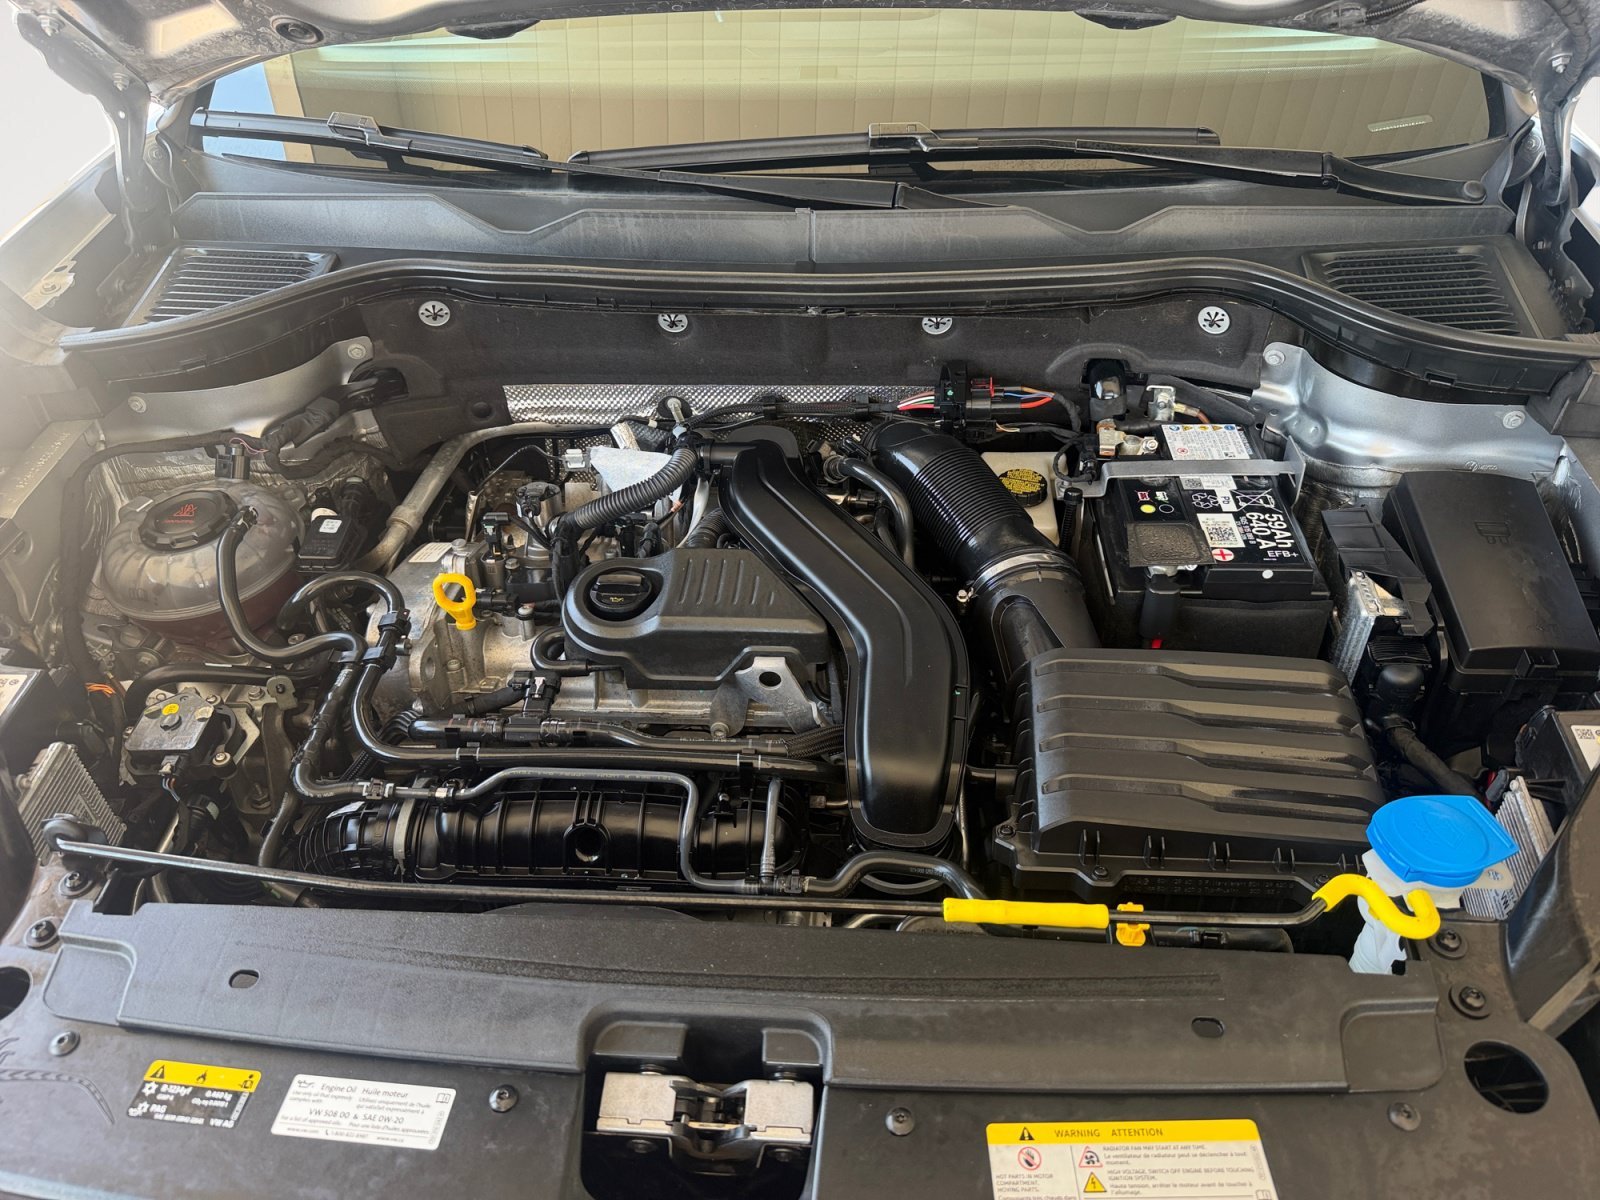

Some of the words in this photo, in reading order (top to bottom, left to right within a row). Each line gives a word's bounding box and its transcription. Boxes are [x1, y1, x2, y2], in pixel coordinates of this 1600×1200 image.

[1246, 512, 1272, 536] 640
[1264, 513, 1295, 548] 59Ah
[1255, 538, 1277, 549] A
[1267, 550, 1298, 558] EFB+
[321, 1083, 345, 1093] Engine
[346, 1085, 357, 1093] Oil
[382, 1090, 409, 1098] moteur
[309, 1108, 322, 1116] VW
[323, 1109, 339, 1118] 508
[339, 1111, 351, 1119] 00
[362, 1113, 377, 1121] SAE
[378, 1115, 405, 1124] 0W-20
[1055, 1129, 1101, 1137] WARNING
[1111, 1128, 1163, 1137] ATTENTION
